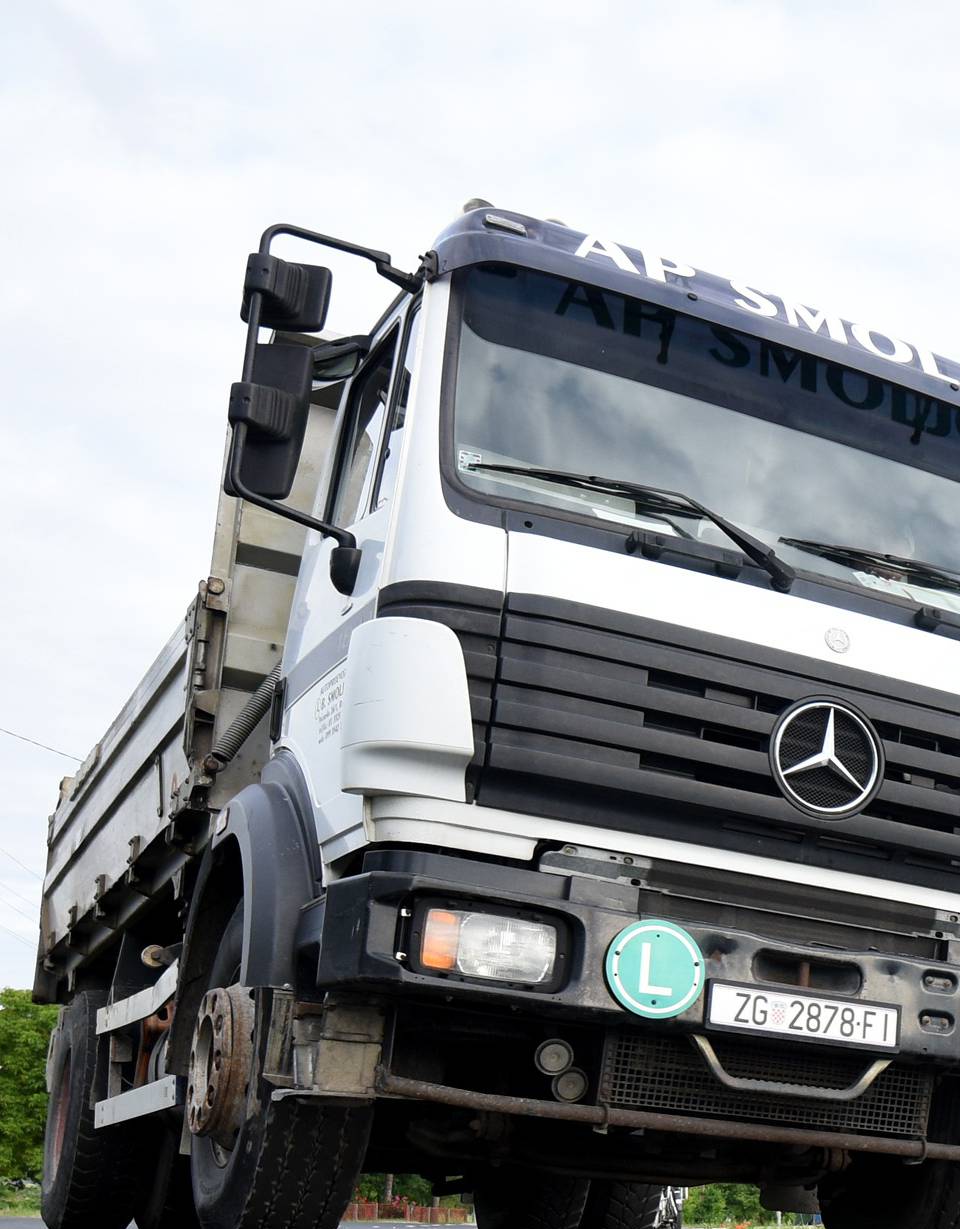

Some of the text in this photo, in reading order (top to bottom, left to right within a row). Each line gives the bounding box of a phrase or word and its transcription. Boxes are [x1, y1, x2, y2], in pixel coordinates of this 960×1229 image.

[574, 233, 696, 283] AP
[639, 942, 673, 996] L
[734, 992, 768, 1025] ZG
